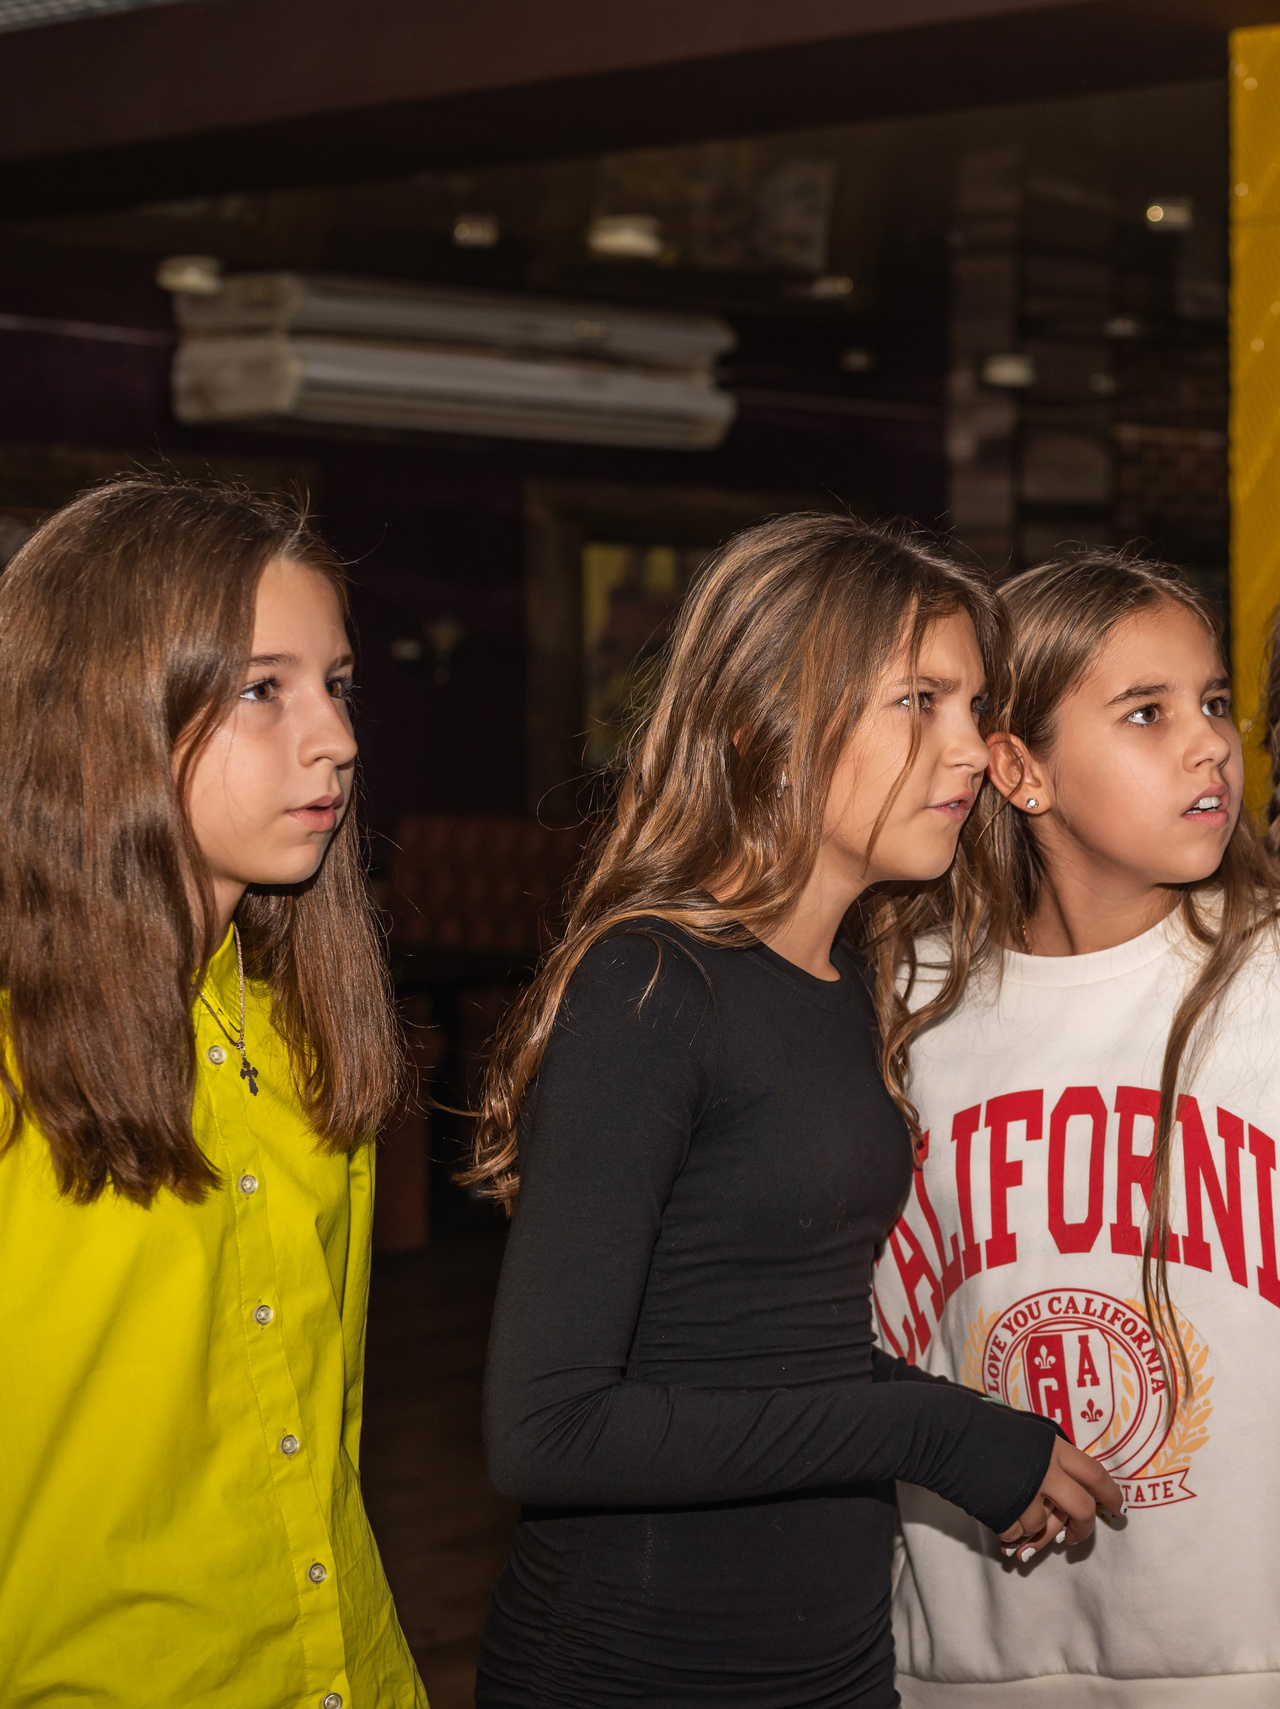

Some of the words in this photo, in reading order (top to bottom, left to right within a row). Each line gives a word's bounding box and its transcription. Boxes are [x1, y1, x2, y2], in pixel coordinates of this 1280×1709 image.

[986, 1334, 1007, 1395] LOVE
[1001, 1300, 1042, 1337] YOU
[1047, 1295, 1166, 1395] CALIFORNIA
[1117, 1480, 1174, 1502] TATE
